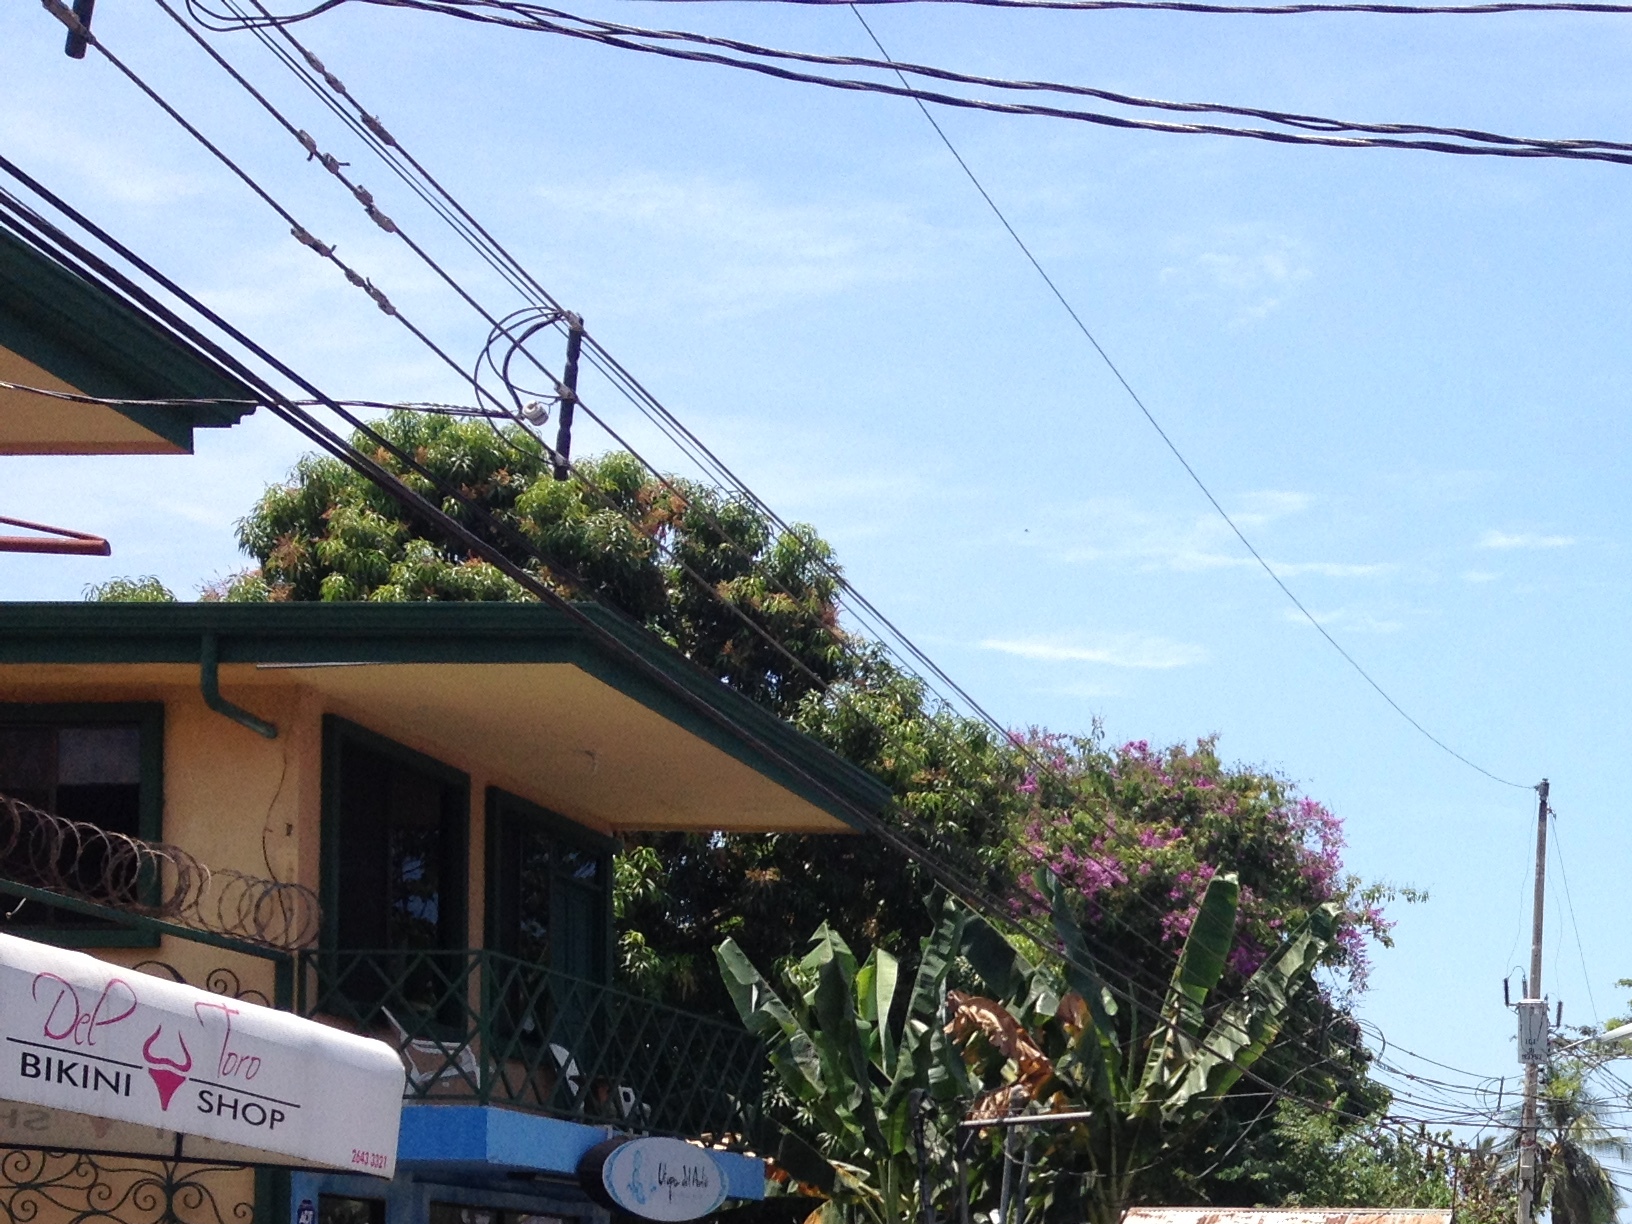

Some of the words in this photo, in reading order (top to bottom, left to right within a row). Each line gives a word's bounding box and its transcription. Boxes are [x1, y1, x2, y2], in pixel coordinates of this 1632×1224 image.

[32, 972, 138, 1046] Del
[195, 1001, 262, 1080] Toro
[20, 1051, 132, 1097] BIKINI
[197, 1089, 286, 1130] SHOP
